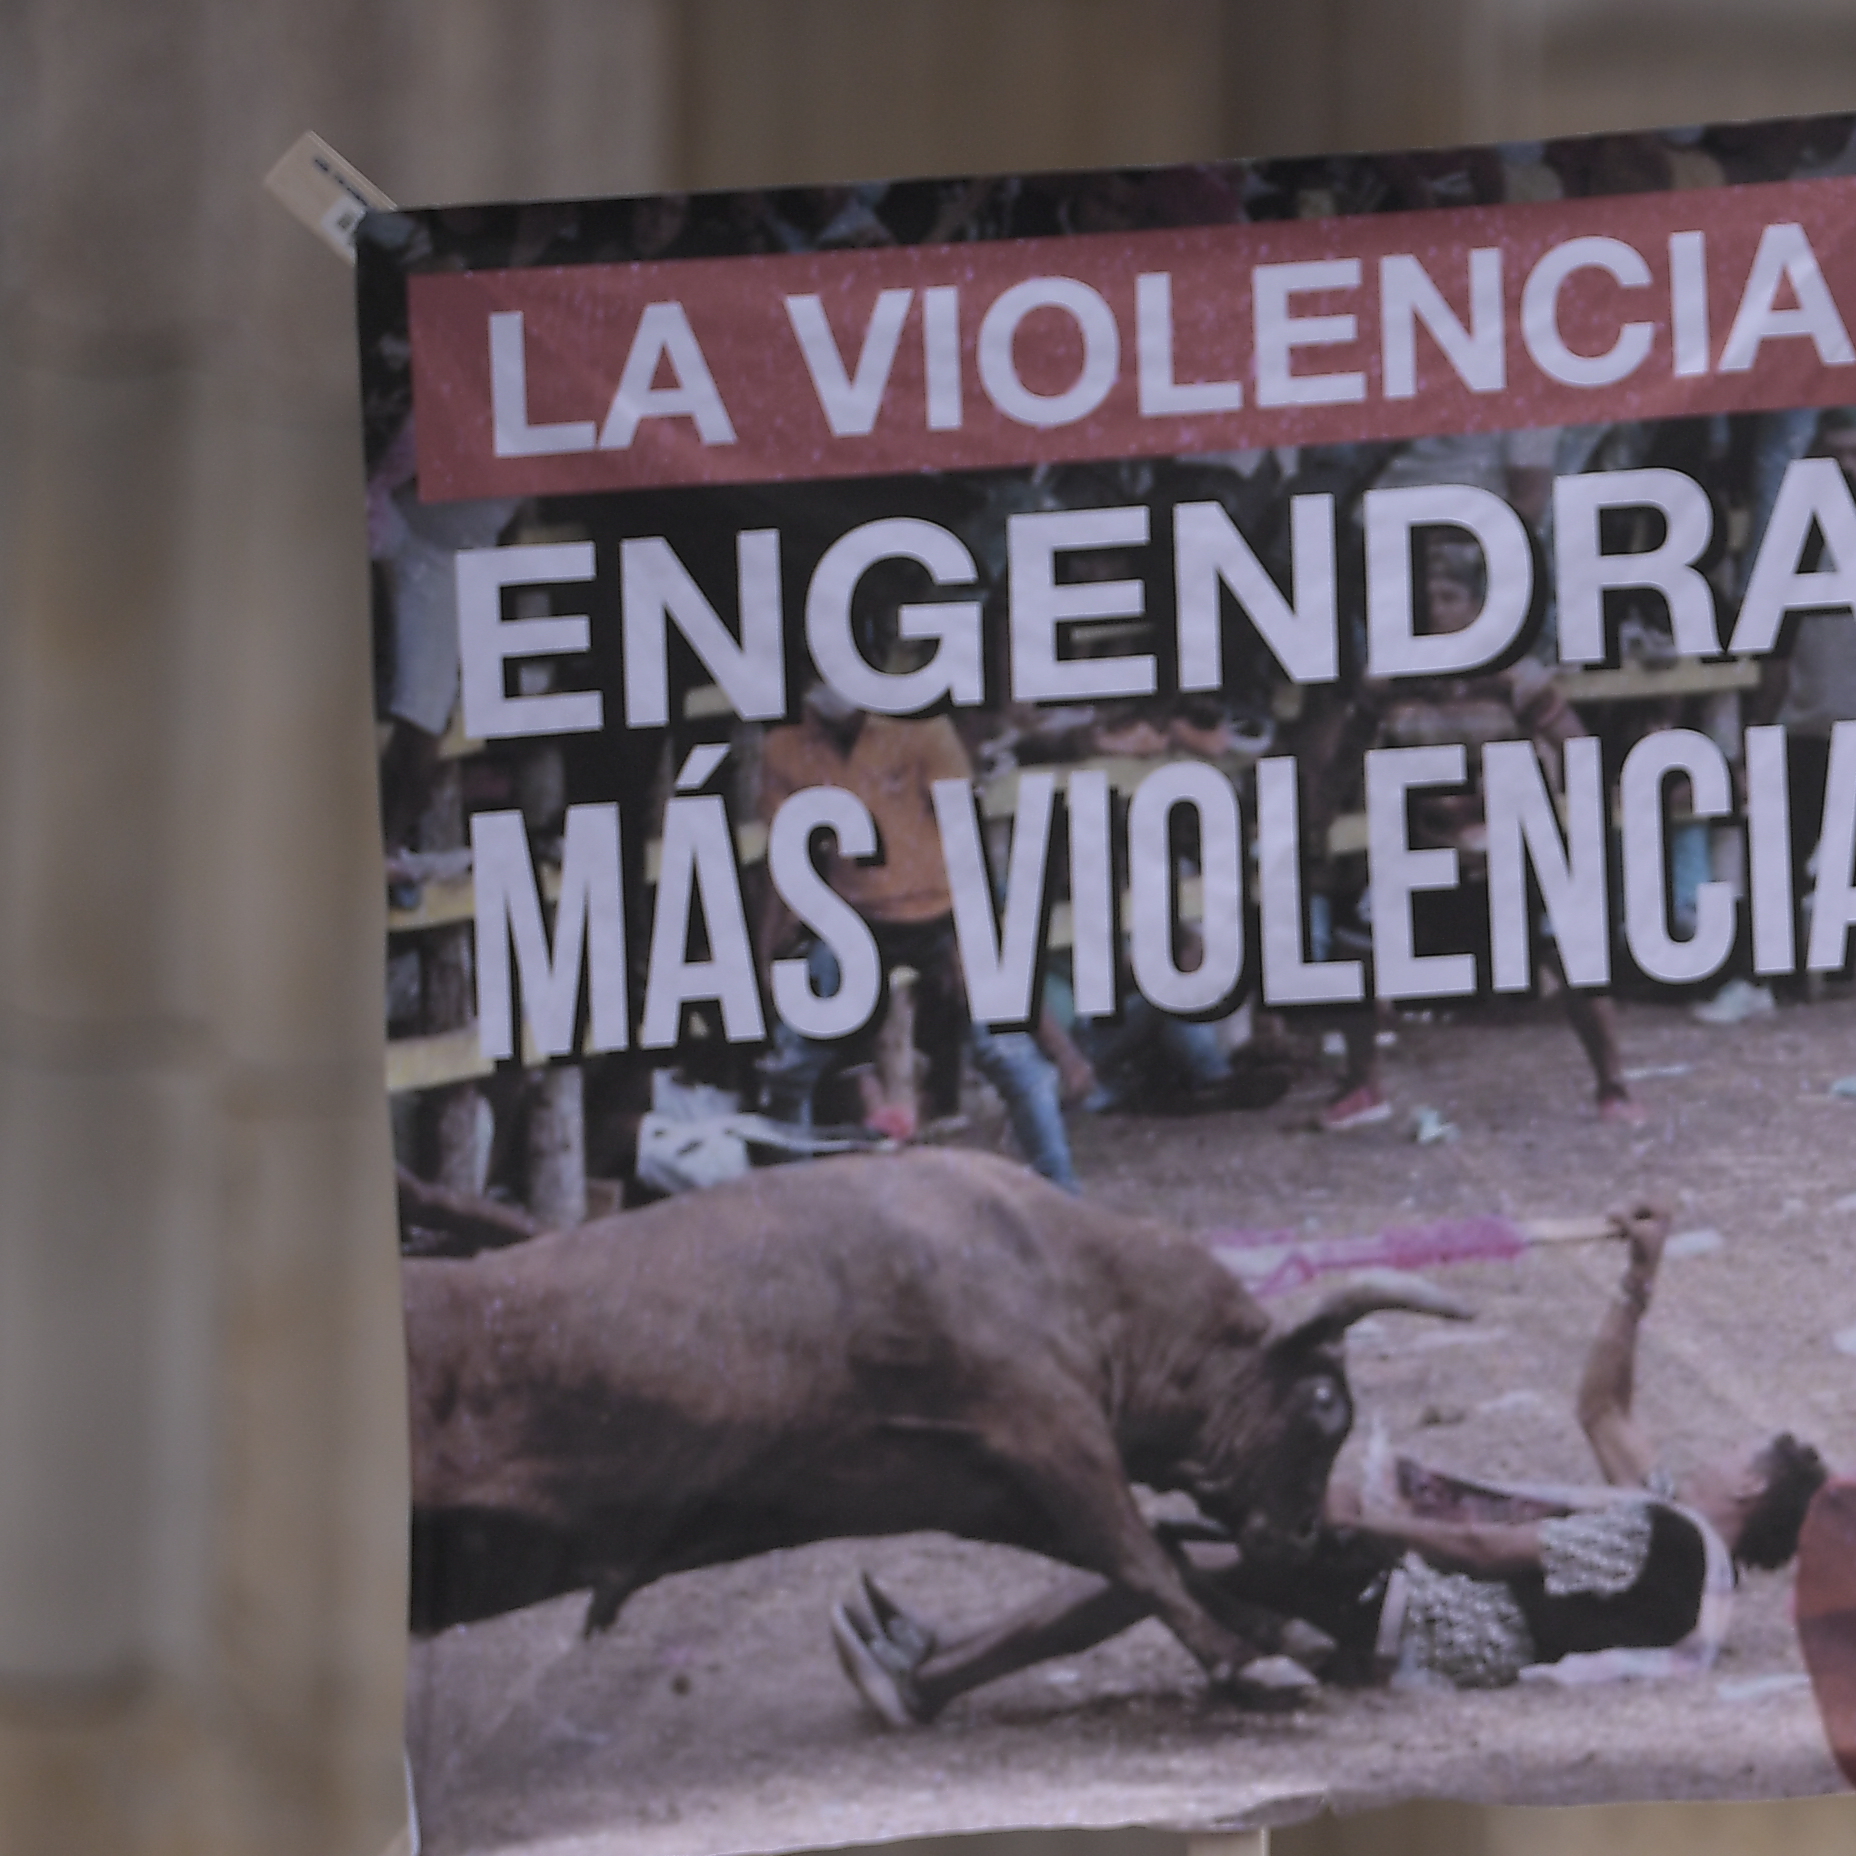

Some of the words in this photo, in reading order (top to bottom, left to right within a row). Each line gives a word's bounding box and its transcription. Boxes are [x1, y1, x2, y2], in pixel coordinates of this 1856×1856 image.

[488, 301, 735, 458] LA
[787, 222, 1856, 438] VIOLENCIA
[471, 742, 880, 1061] MÁS
